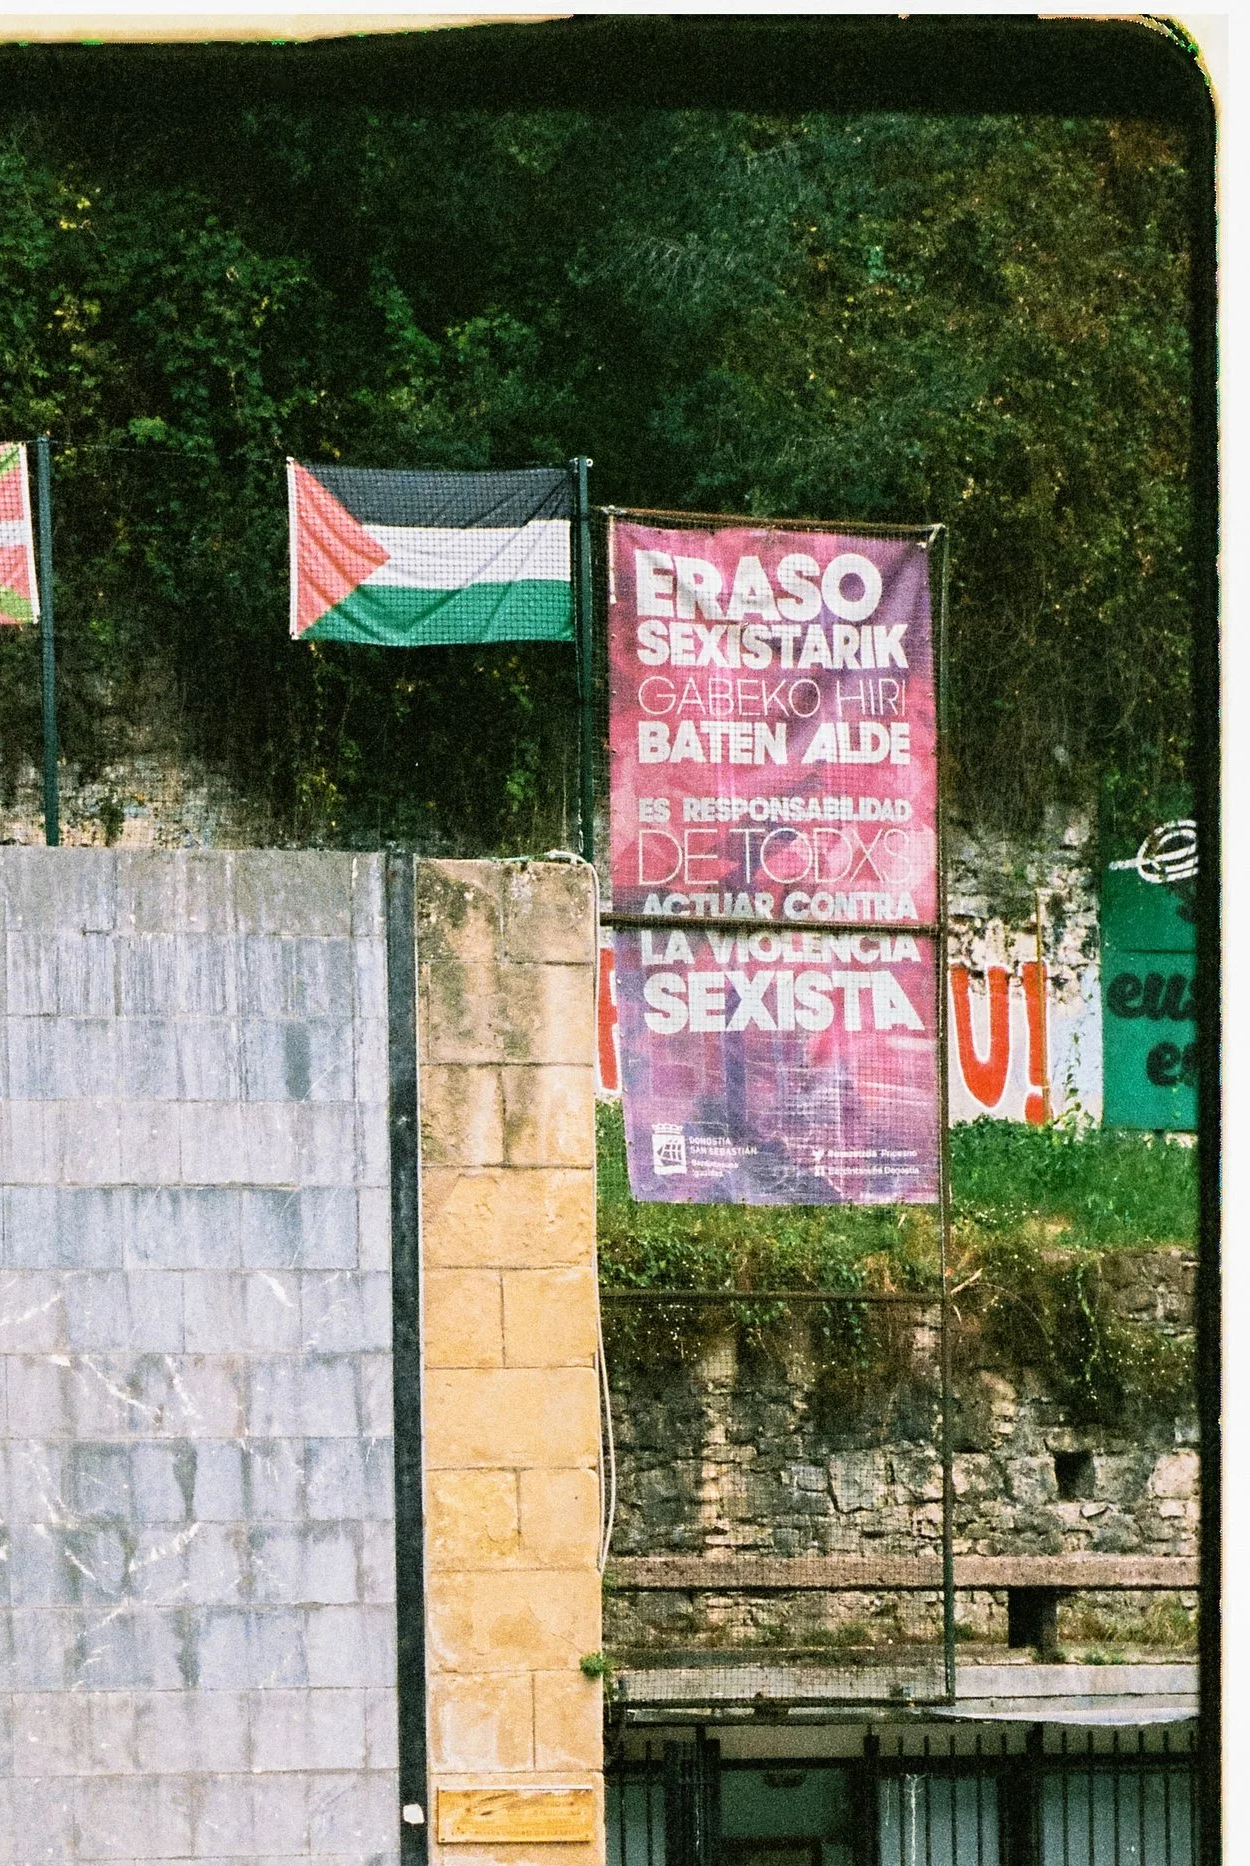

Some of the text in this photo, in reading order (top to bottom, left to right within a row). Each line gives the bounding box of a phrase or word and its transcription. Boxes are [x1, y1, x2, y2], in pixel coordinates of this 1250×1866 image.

[635, 549, 883, 622] ERASO
[637, 619, 909, 669] SEXISTARIK
[638, 675, 905, 718] GABEKO HIRI
[638, 720, 910, 765] BATEN ALDE
[639, 797, 913, 822] ES RESPONSABILIDAD
[639, 827, 914, 885] DE TODXS
[642, 891, 918, 921] ACTUAR CONTRA
[640, 929, 921, 965] LA VIOLENCIA
[644, 969, 925, 1035] SEXISTA
[1107, 972, 1197, 1020] eu
